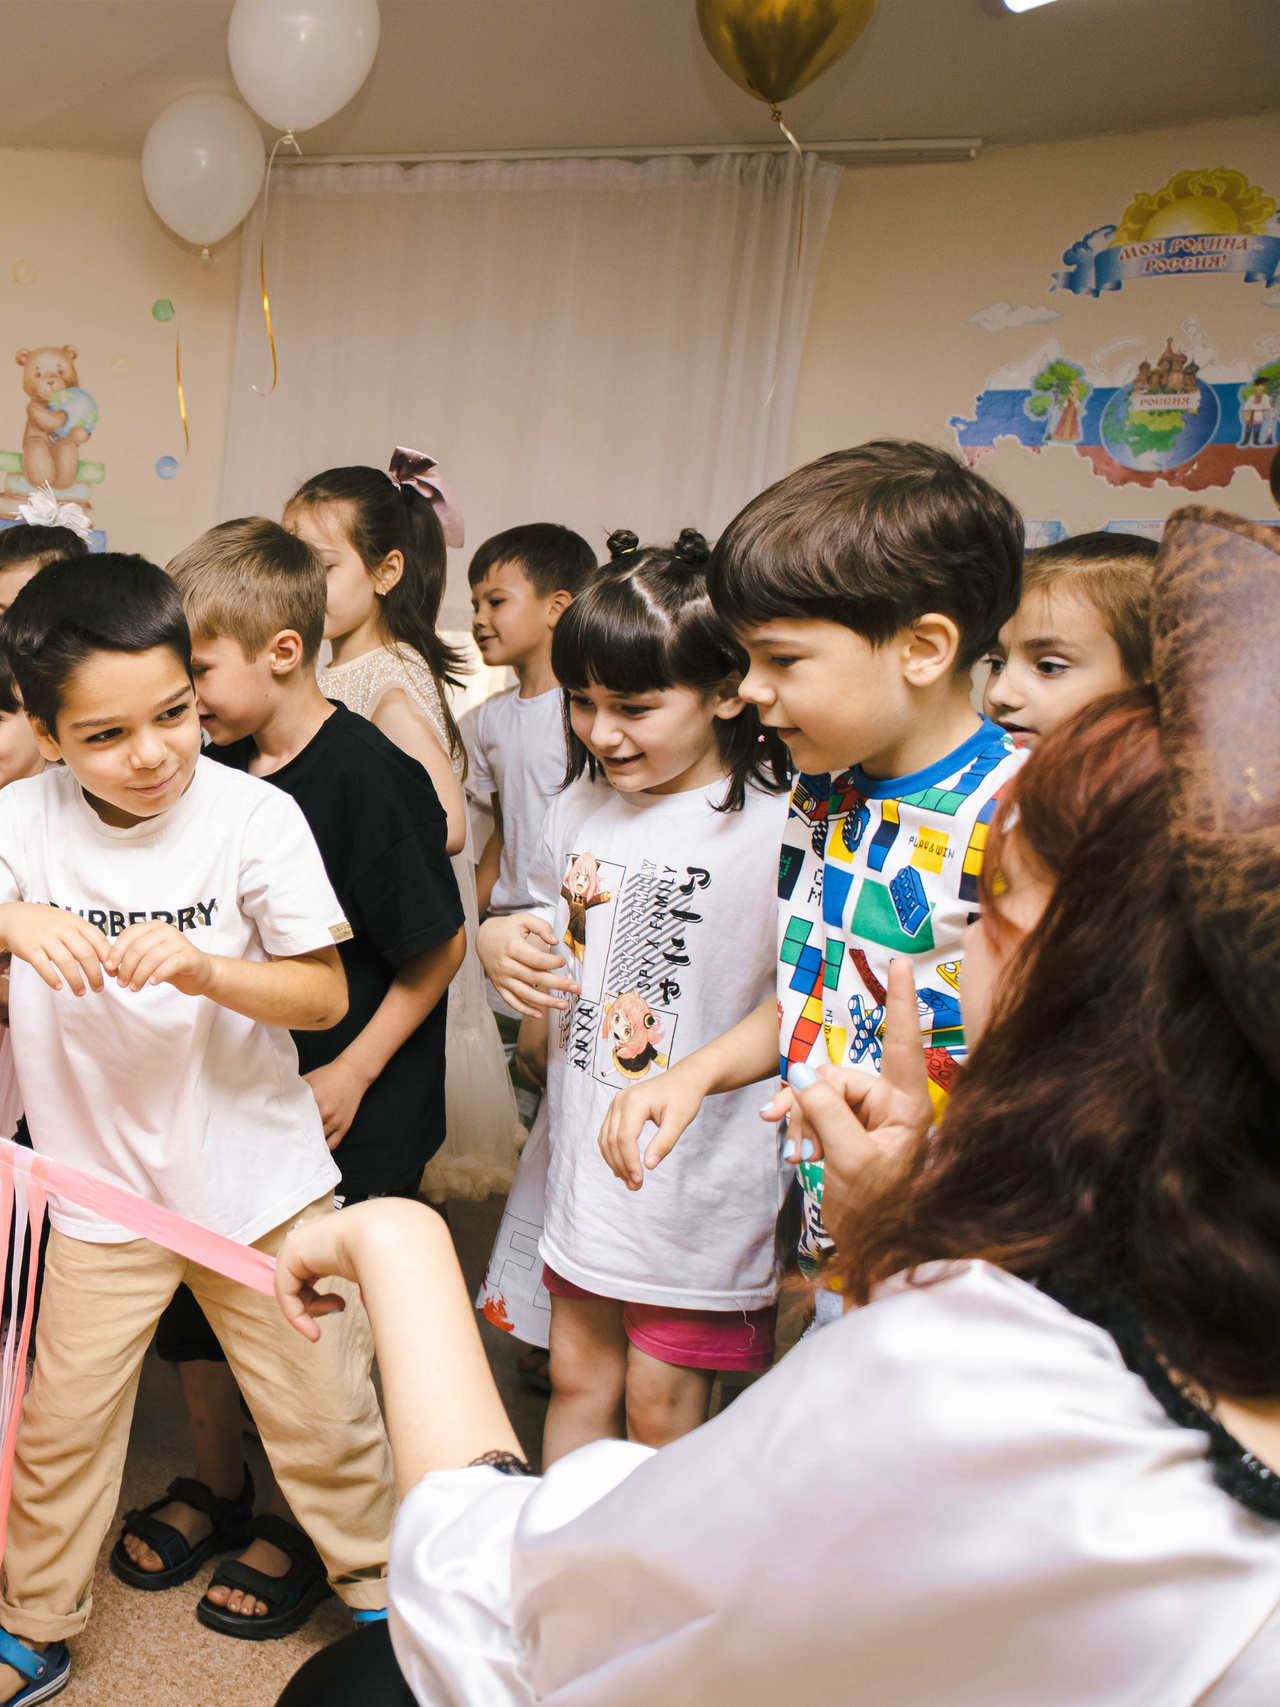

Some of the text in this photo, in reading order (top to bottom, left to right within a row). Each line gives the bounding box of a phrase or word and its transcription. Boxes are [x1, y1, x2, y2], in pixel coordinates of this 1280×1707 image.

[1119, 240, 1165, 260] МОЯ
[1170, 237, 1248, 253] РОДИНА
[1145, 254, 1227, 272] РОССИЯ!
[1139, 397, 1190, 407] РОССИЯ
[637, 865, 677, 991] SPY X FAMILY
[574, 1005, 594, 1071] ANYA
